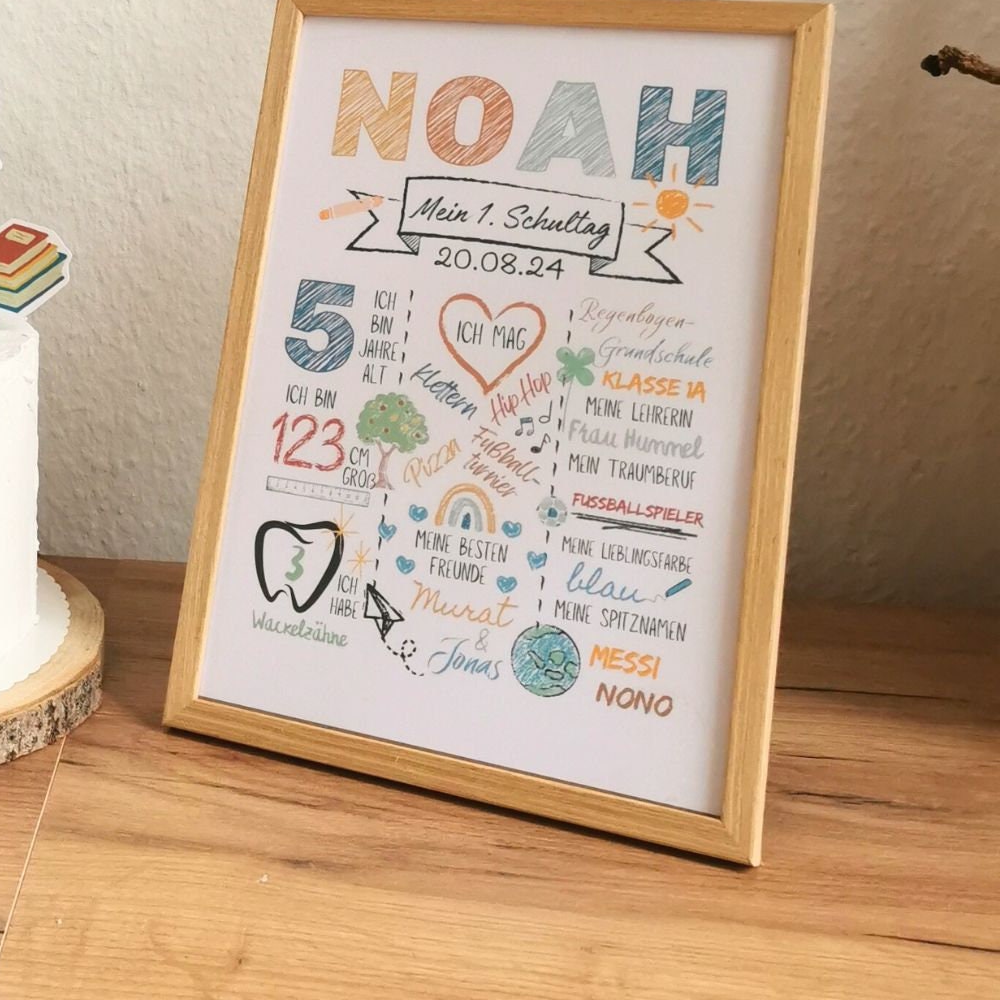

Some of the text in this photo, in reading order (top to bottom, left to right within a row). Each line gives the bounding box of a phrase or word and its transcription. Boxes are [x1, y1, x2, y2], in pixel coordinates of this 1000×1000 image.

[331, 69, 728, 186] NOAH
[408, 196, 612, 250] Mein 1. Schultag
[433, 246, 566, 280] 20.08.24
[374, 290, 397, 311] ICH
[578, 297, 696, 340] Regenbogen-
[284, 278, 356, 373] 5
[370, 314, 395, 335] BIN
[456, 320, 528, 350] ICH MAG
[358, 339, 399, 362] JAHRE
[592, 336, 714, 368] Grundschule
[362, 364, 388, 385] ALT
[409, 363, 478, 421] Klettern
[601, 370, 707, 403] KLASSE 1A
[285, 384, 337, 409] ICH BIN
[586, 396, 693, 428] MEINE LEHRERIN
[272, 411, 346, 472] 123
[350, 446, 370, 467] CM
[471, 426, 540, 485] Fußball-
[568, 419, 705, 460] Frau Hummel
[463, 452, 517, 497] turnier
[568, 453, 697, 490] MEIN TRAUMBERUF
[571, 492, 704, 528] FUSSBALLSPIELER
[284, 545, 306, 582] 3
[415, 529, 508, 563] MEINE BESTEN
[562, 536, 693, 574] MEINE LIEBLINGSFARBE
[337, 574, 359, 595] ICH
[429, 556, 488, 585] FREUNDE
[566, 561, 646, 603] blau
[330, 597, 360, 620] HABE
[410, 580, 518, 628] Murat
[554, 599, 687, 642] MEINE SPITZNAMEN
[252, 609, 349, 648] Wackelzähne
[474, 628, 489, 652] &
[428, 637, 504, 681] Jonas
[589, 643, 662, 680] MESSI
[595, 682, 674, 717] NONO
